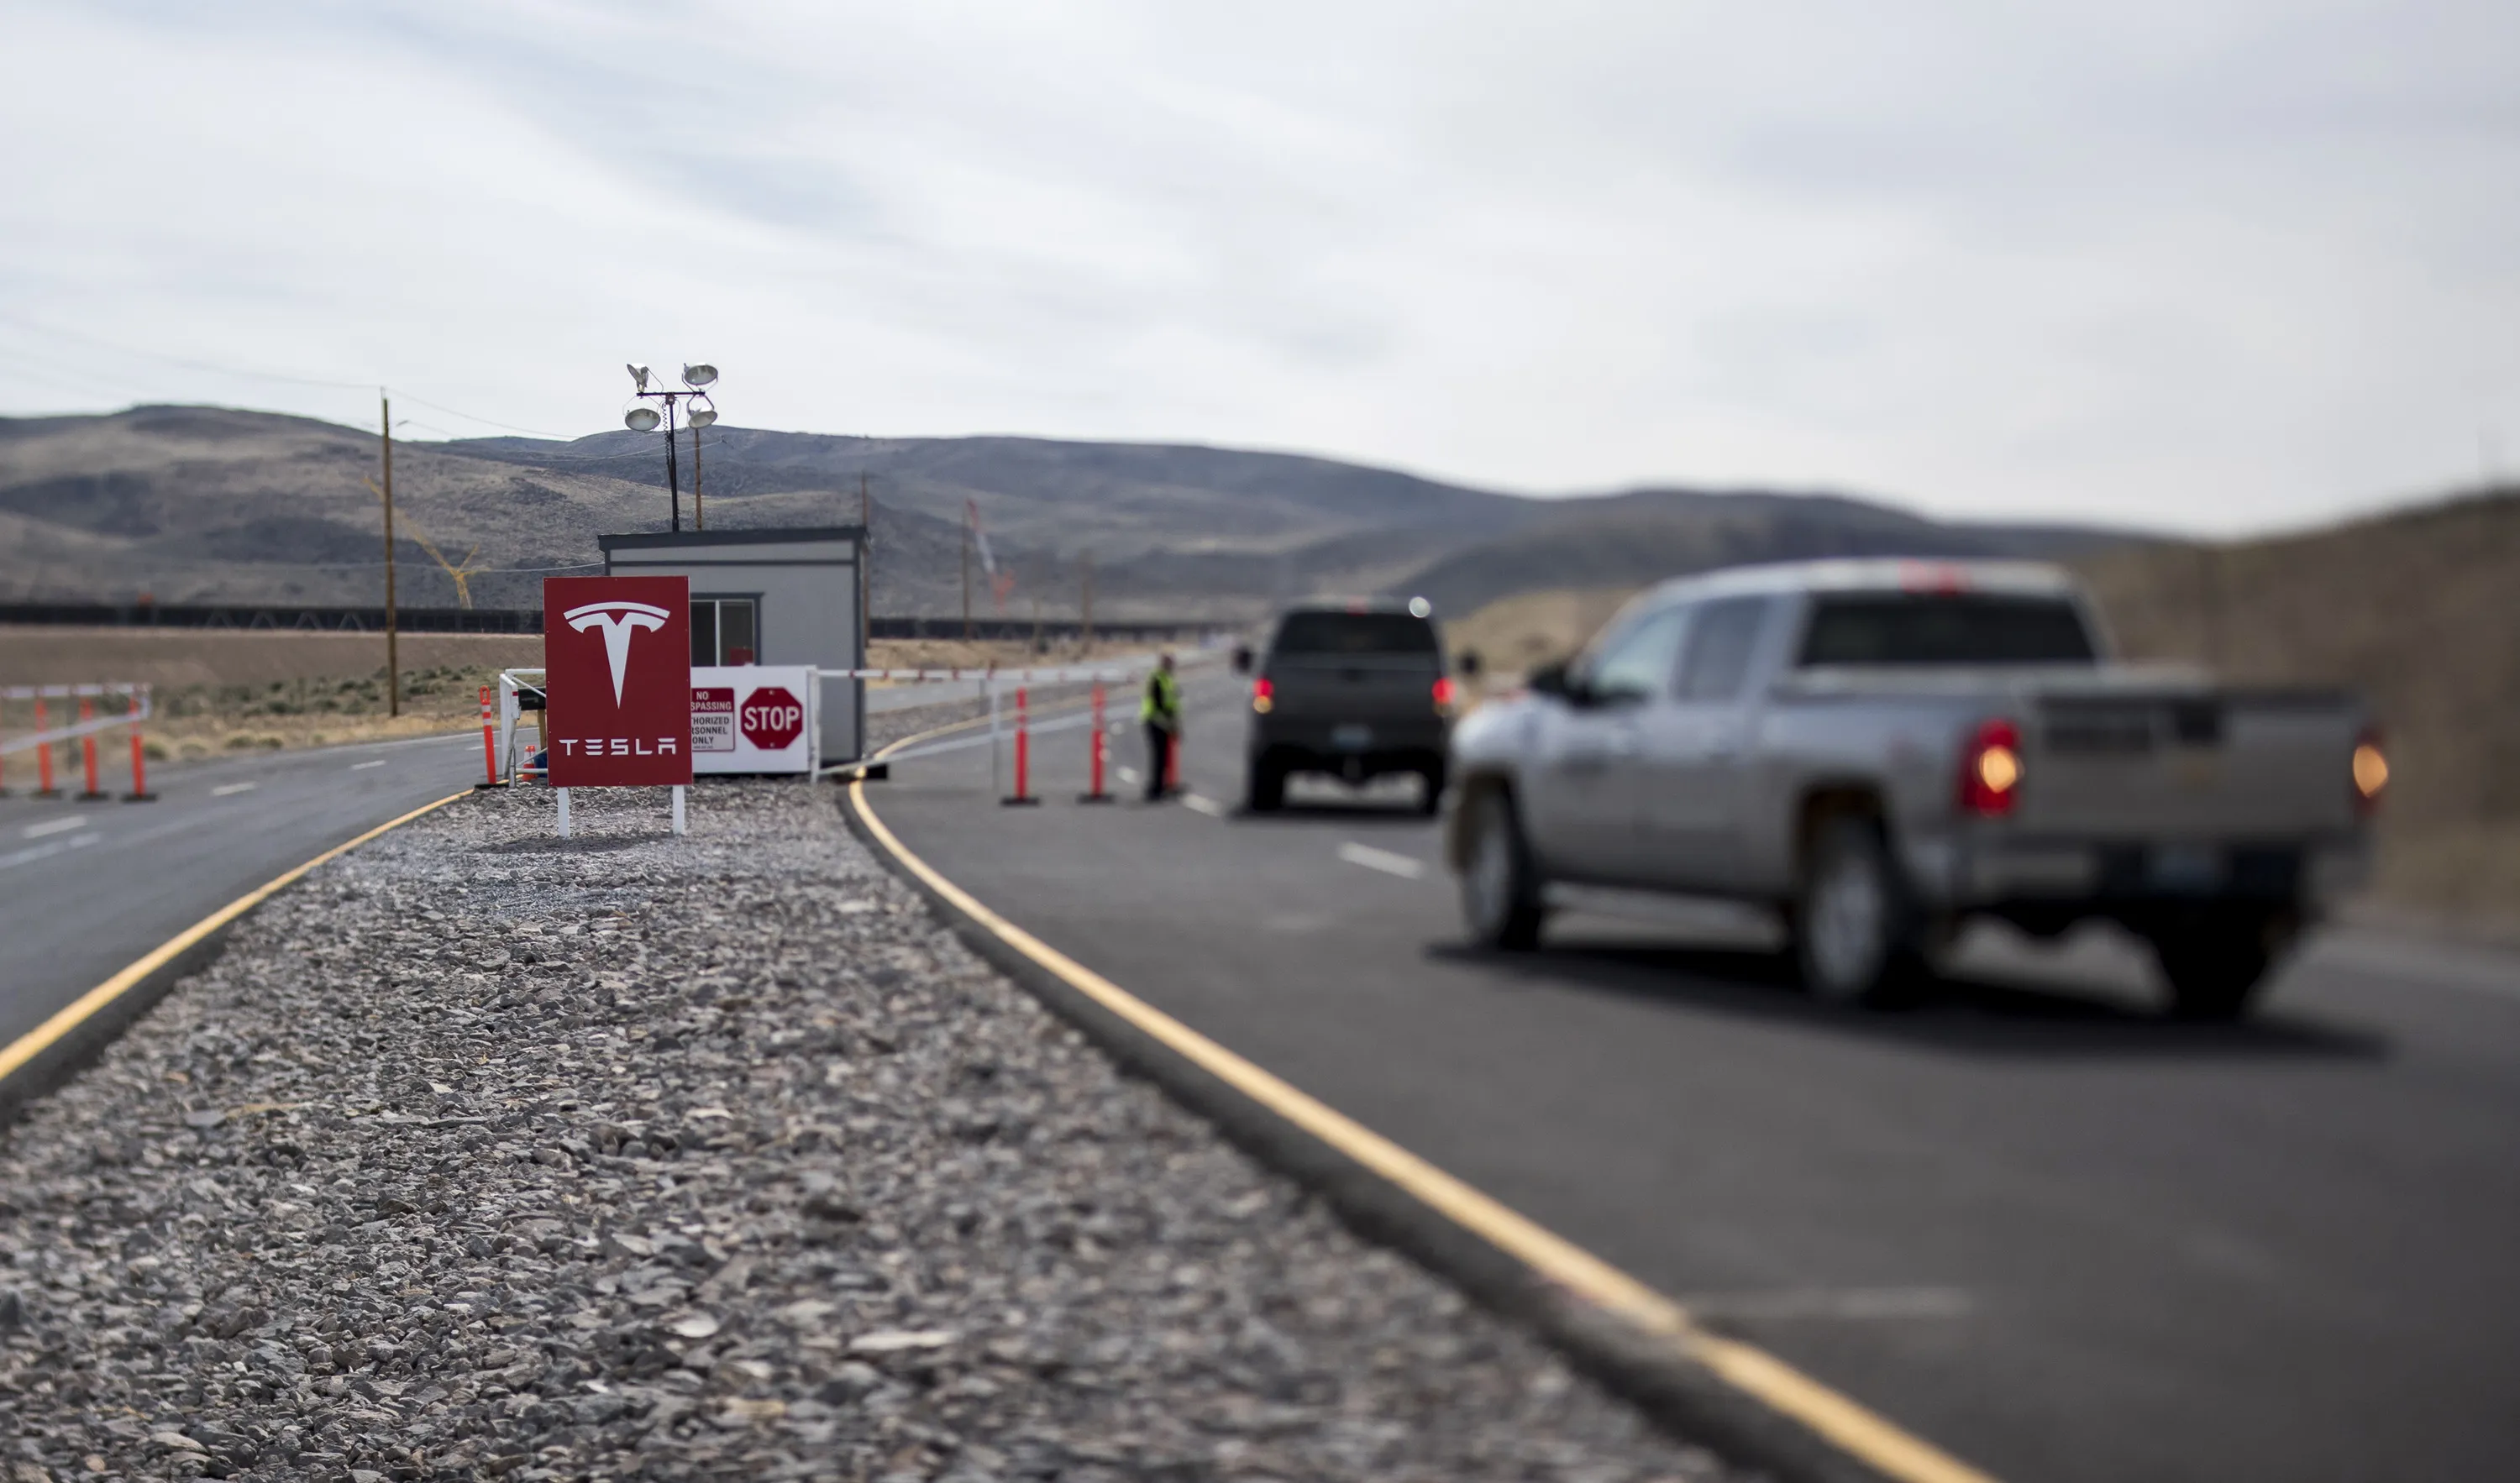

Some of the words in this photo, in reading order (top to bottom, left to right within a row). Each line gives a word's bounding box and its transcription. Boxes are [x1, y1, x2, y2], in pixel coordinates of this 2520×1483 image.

[696, 691, 709, 700] NO
[691, 701, 732, 710] SPASSING
[744, 706, 800, 731] STOP
[692, 736, 714, 745] ONLY
[559, 738, 676, 756] TESLA
